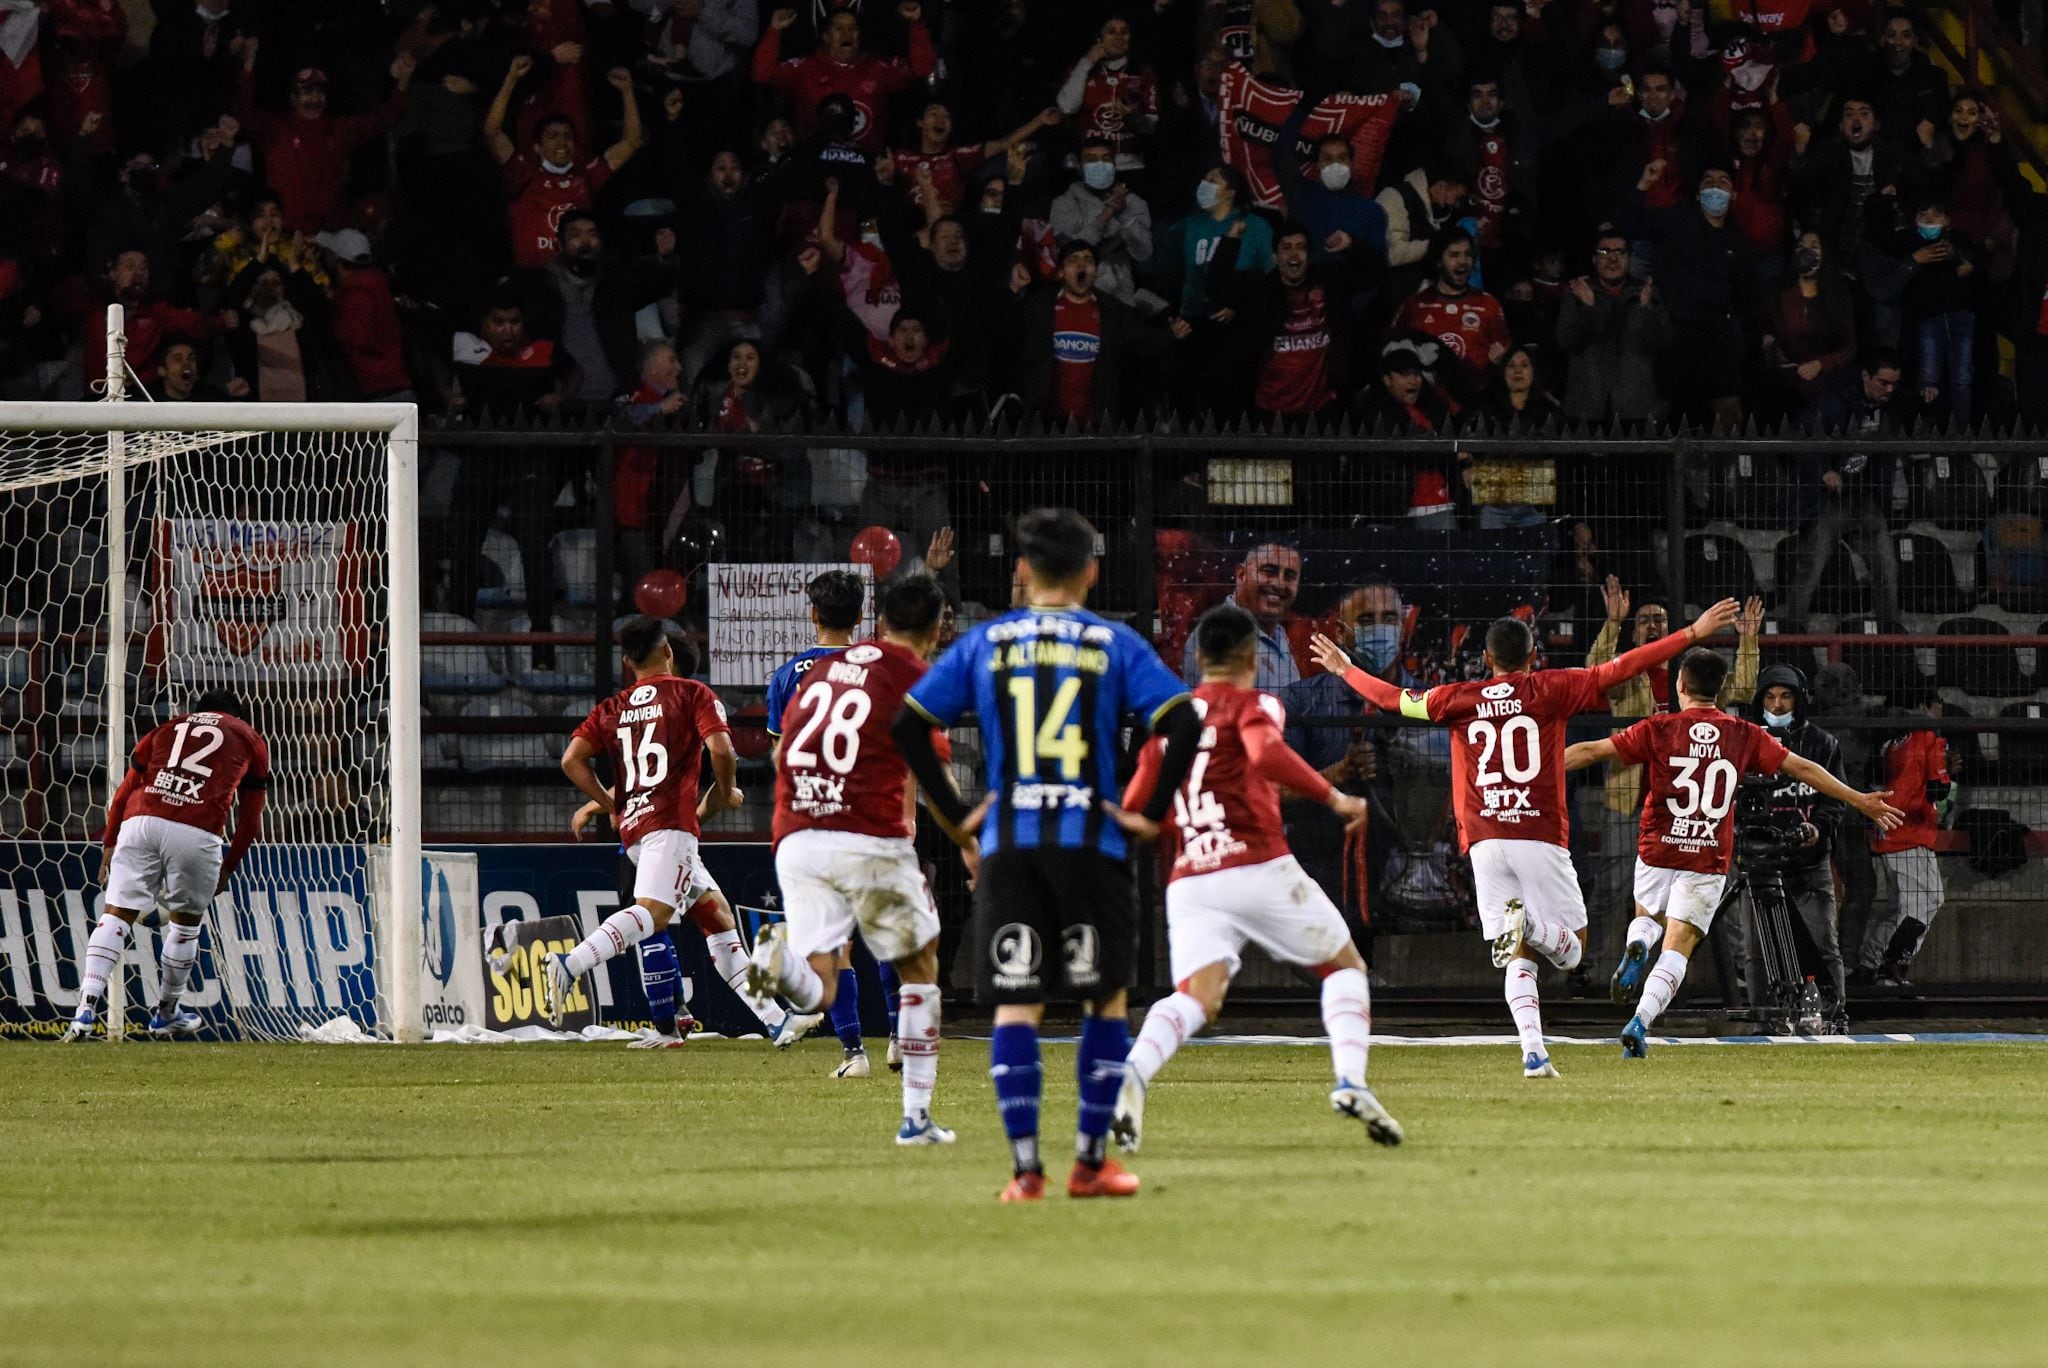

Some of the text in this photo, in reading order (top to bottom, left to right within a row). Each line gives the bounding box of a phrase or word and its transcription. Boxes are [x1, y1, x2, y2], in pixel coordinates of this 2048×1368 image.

[186, 716, 220, 726] RUBIO
[619, 703, 663, 724] ARAVENA
[787, 681, 872, 775] 28
[1008, 677, 1088, 780] 14
[1476, 699, 1522, 718] MATEOS
[167, 722, 224, 778] 12
[616, 722, 668, 793] 16
[1467, 715, 1541, 787] 20
[1689, 743, 1721, 759] MOYA
[1666, 756, 1738, 820] 30
